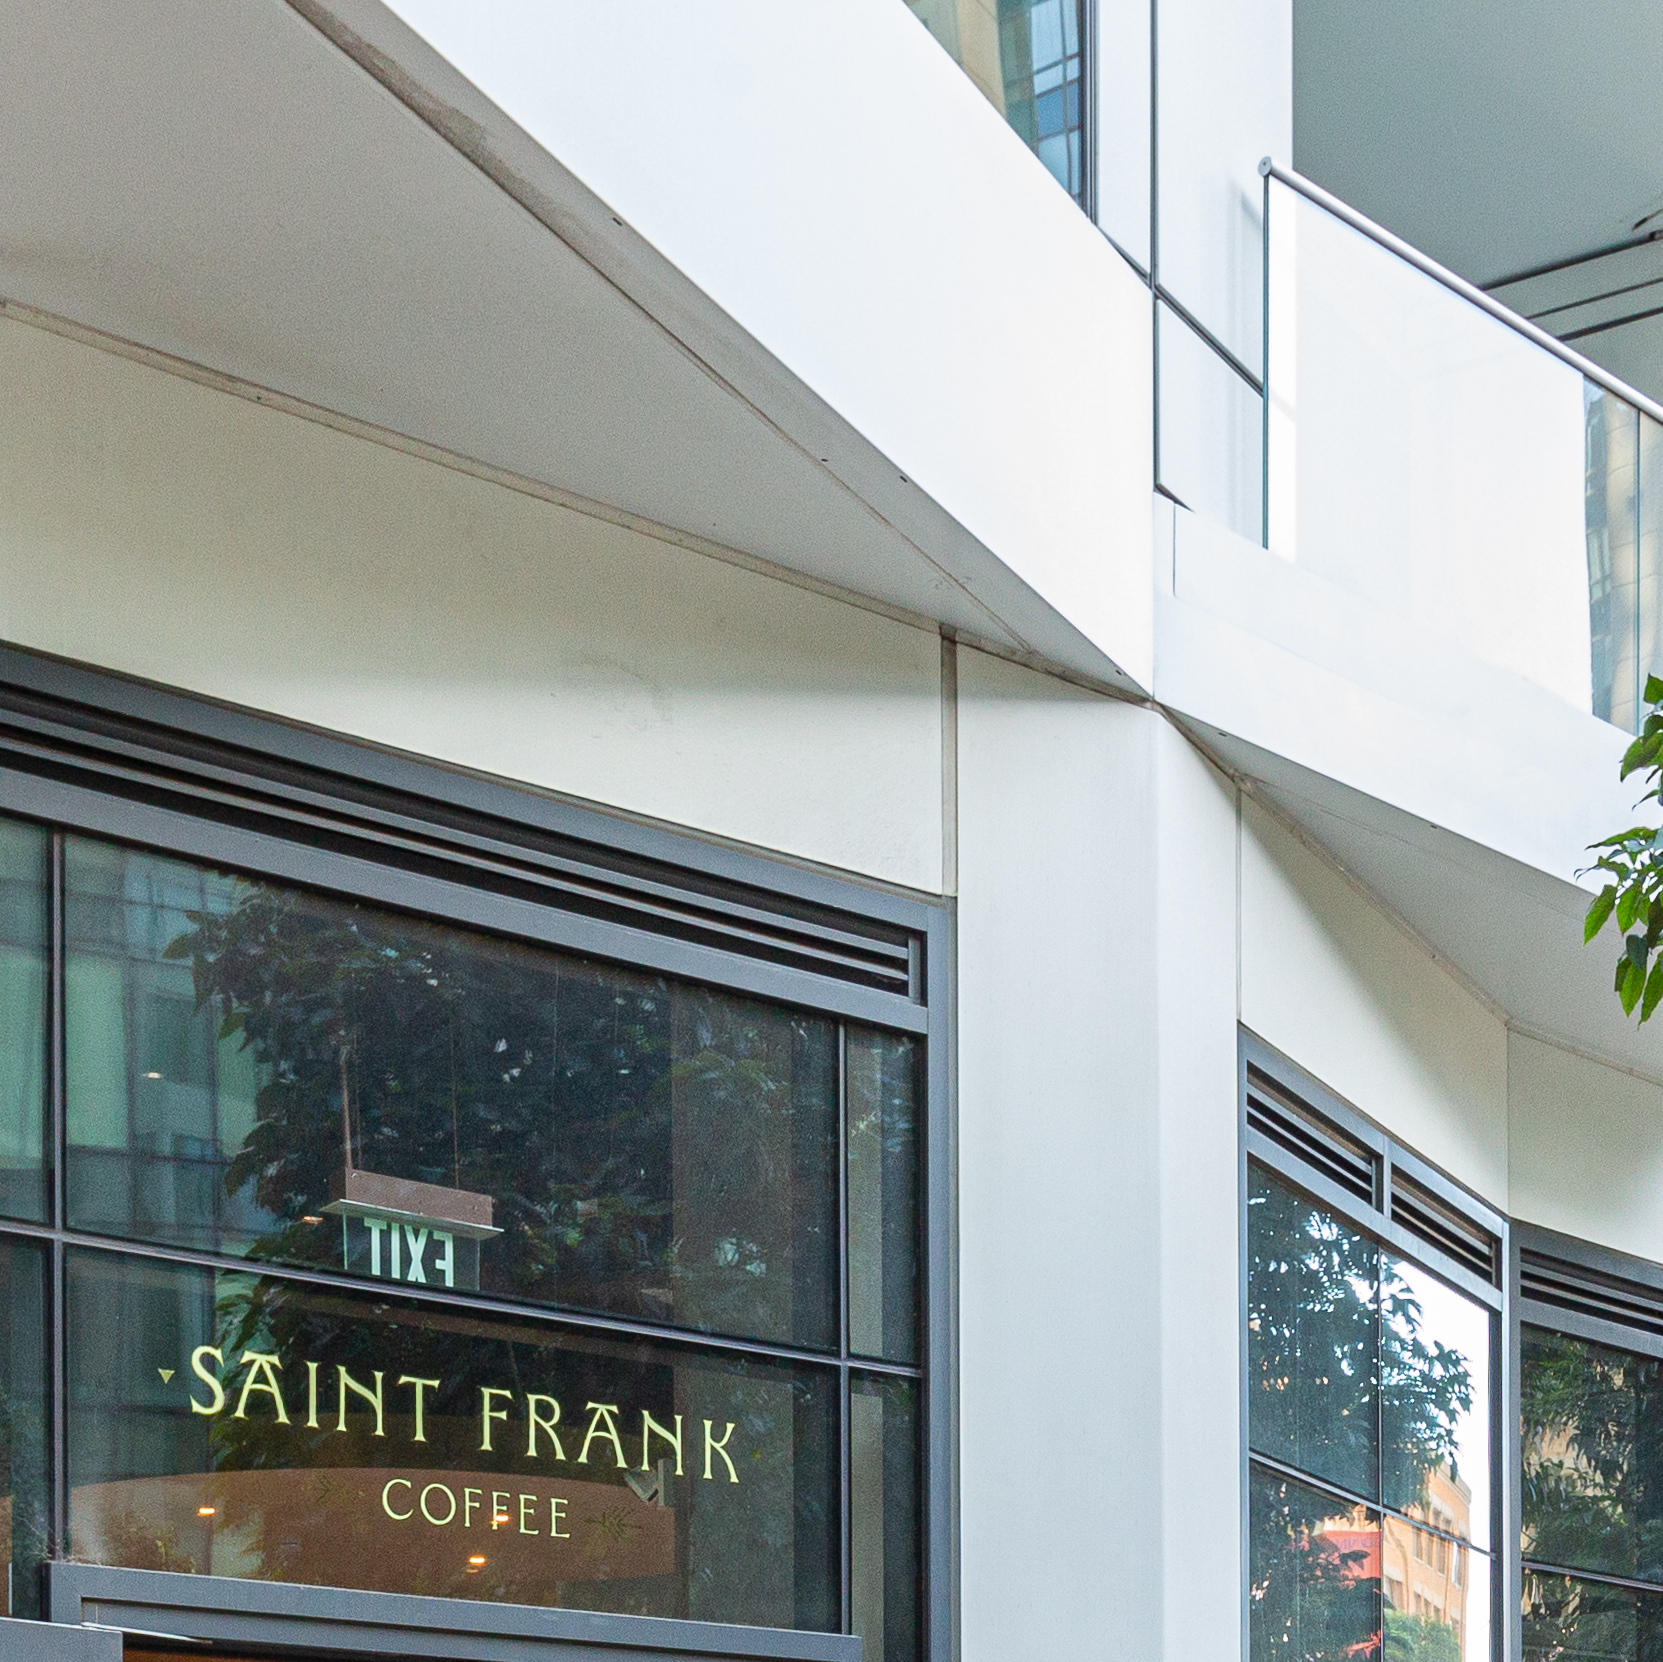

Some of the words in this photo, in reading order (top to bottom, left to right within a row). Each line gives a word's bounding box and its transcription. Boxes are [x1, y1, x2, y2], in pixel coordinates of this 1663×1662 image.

[190, 1344, 441, 1443] SAINT
[479, 1386, 741, 1484] FRANK
[381, 1477, 571, 1540] COFFEE
